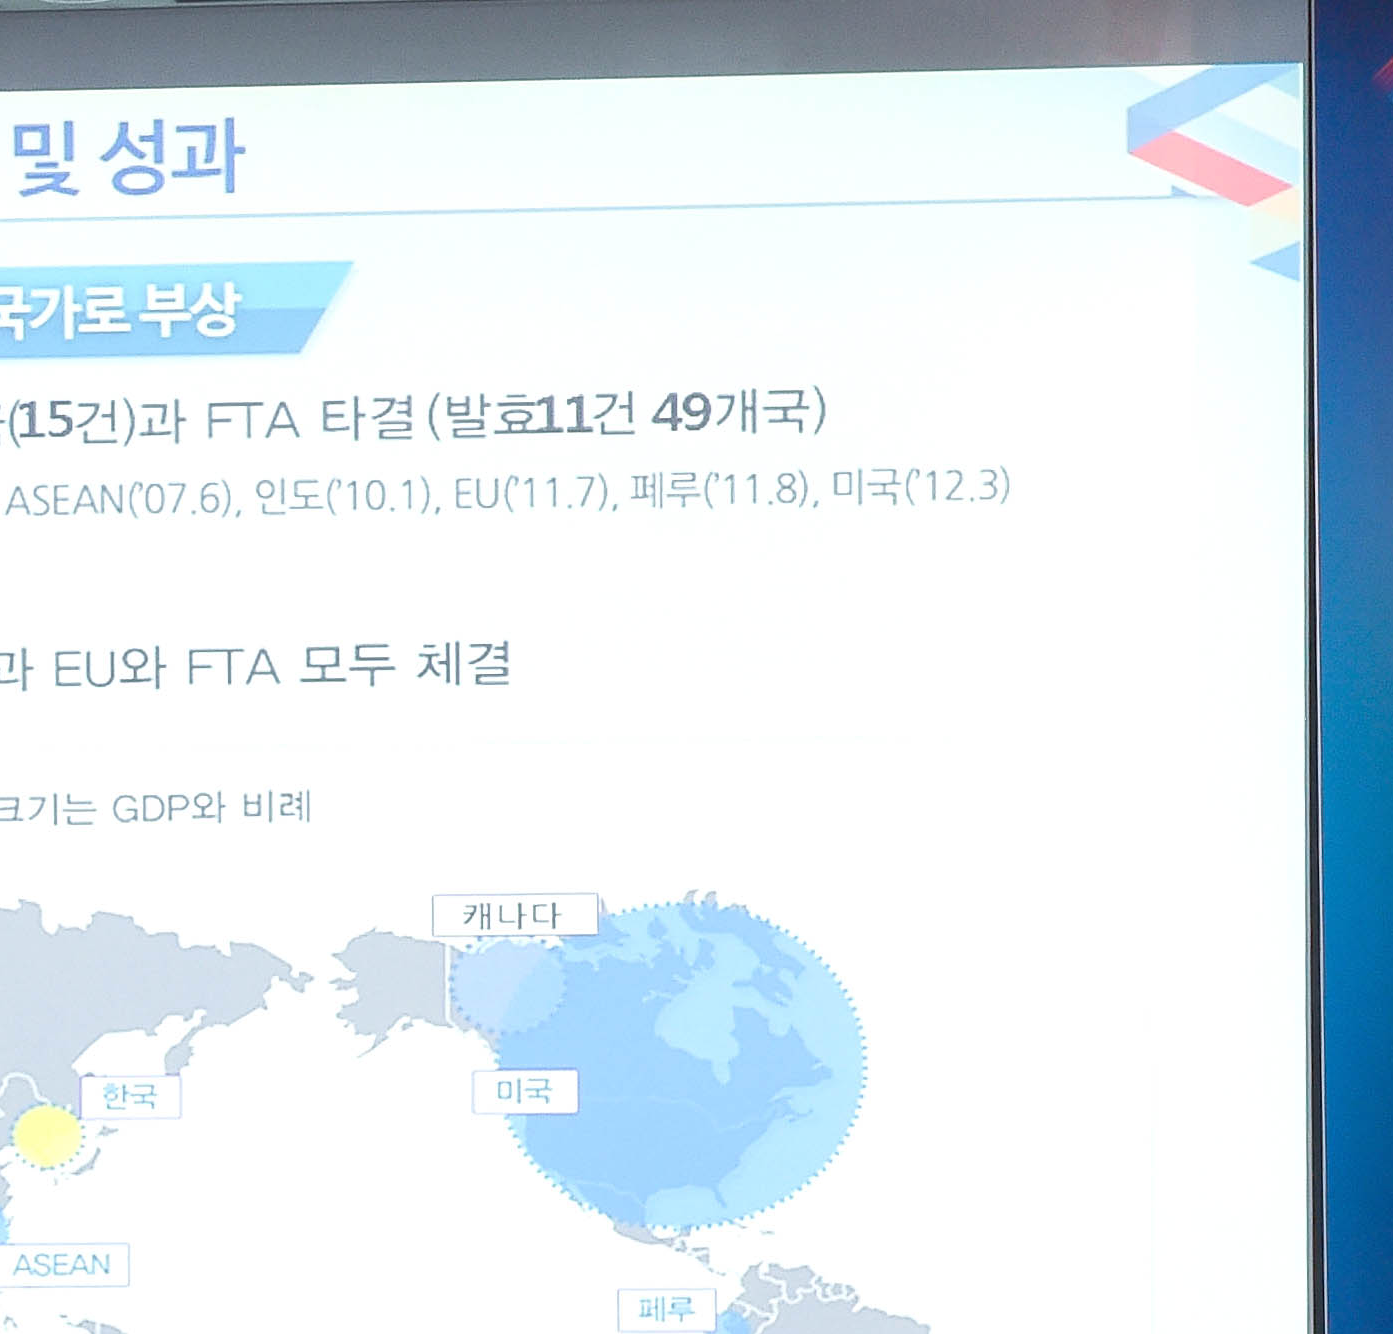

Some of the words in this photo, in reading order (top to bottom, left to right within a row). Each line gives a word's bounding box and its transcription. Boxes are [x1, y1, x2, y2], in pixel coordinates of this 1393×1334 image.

[14, 120, 79, 197] 및
[100, 117, 246, 196] 성과
[139, 281, 243, 337] 부상
[208, 402, 300, 438] FTA
[323, 395, 412, 441] 타결
[429, 391, 635, 441] (발효11건
[652, 386, 825, 434] 49개국)
[55, 646, 167, 689] EU와
[189, 649, 280, 685] FTA
[300, 644, 396, 687] 모두
[417, 641, 509, 685] 체결
[113, 791, 226, 823] GDP와
[244, 790, 310, 823] 비례
[464, 902, 561, 930] 캐나다
[103, 1083, 157, 1110] 한국
[498, 1078, 552, 1104] 미국
[13, 1253, 109, 1277] ASEAN
[639, 1296, 695, 1322] 페루
